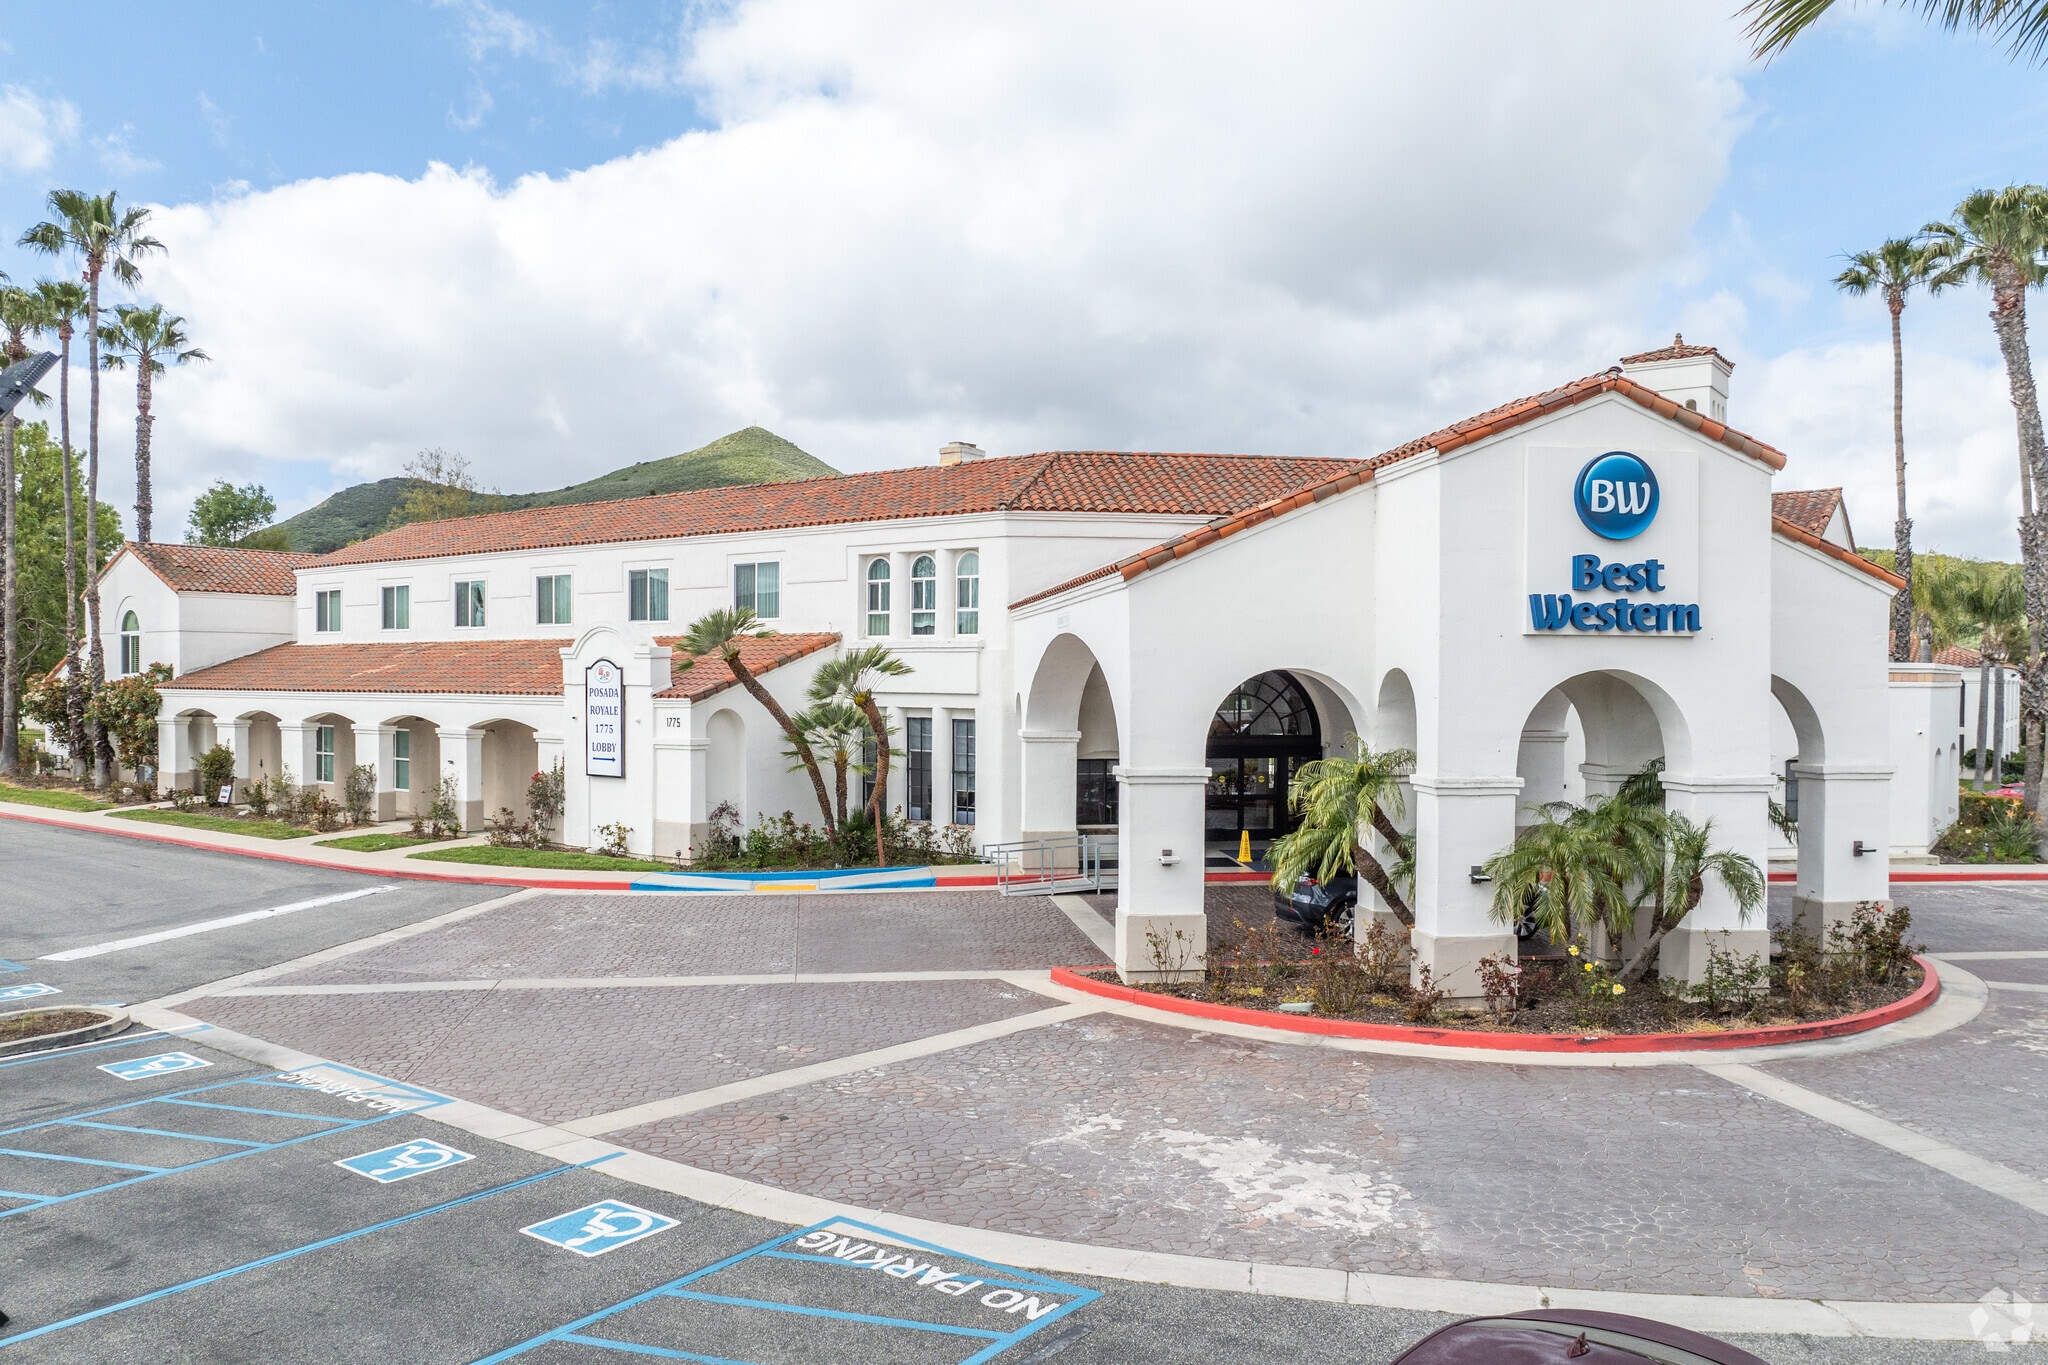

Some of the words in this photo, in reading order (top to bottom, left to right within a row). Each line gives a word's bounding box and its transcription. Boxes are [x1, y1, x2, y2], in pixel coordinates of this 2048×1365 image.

[1591, 479, 1650, 515] BW
[1572, 554, 1666, 592] Best
[1529, 593, 1702, 632] Western
[589, 687, 619, 698] POSADA
[590, 705, 619, 716] ROYALE
[595, 724, 614, 734] 1775
[666, 717, 681, 728] 1775
[592, 742, 617, 753] LOBBY
[796, 1231, 984, 1296] PARKING
[980, 1289, 1060, 1321] NO
